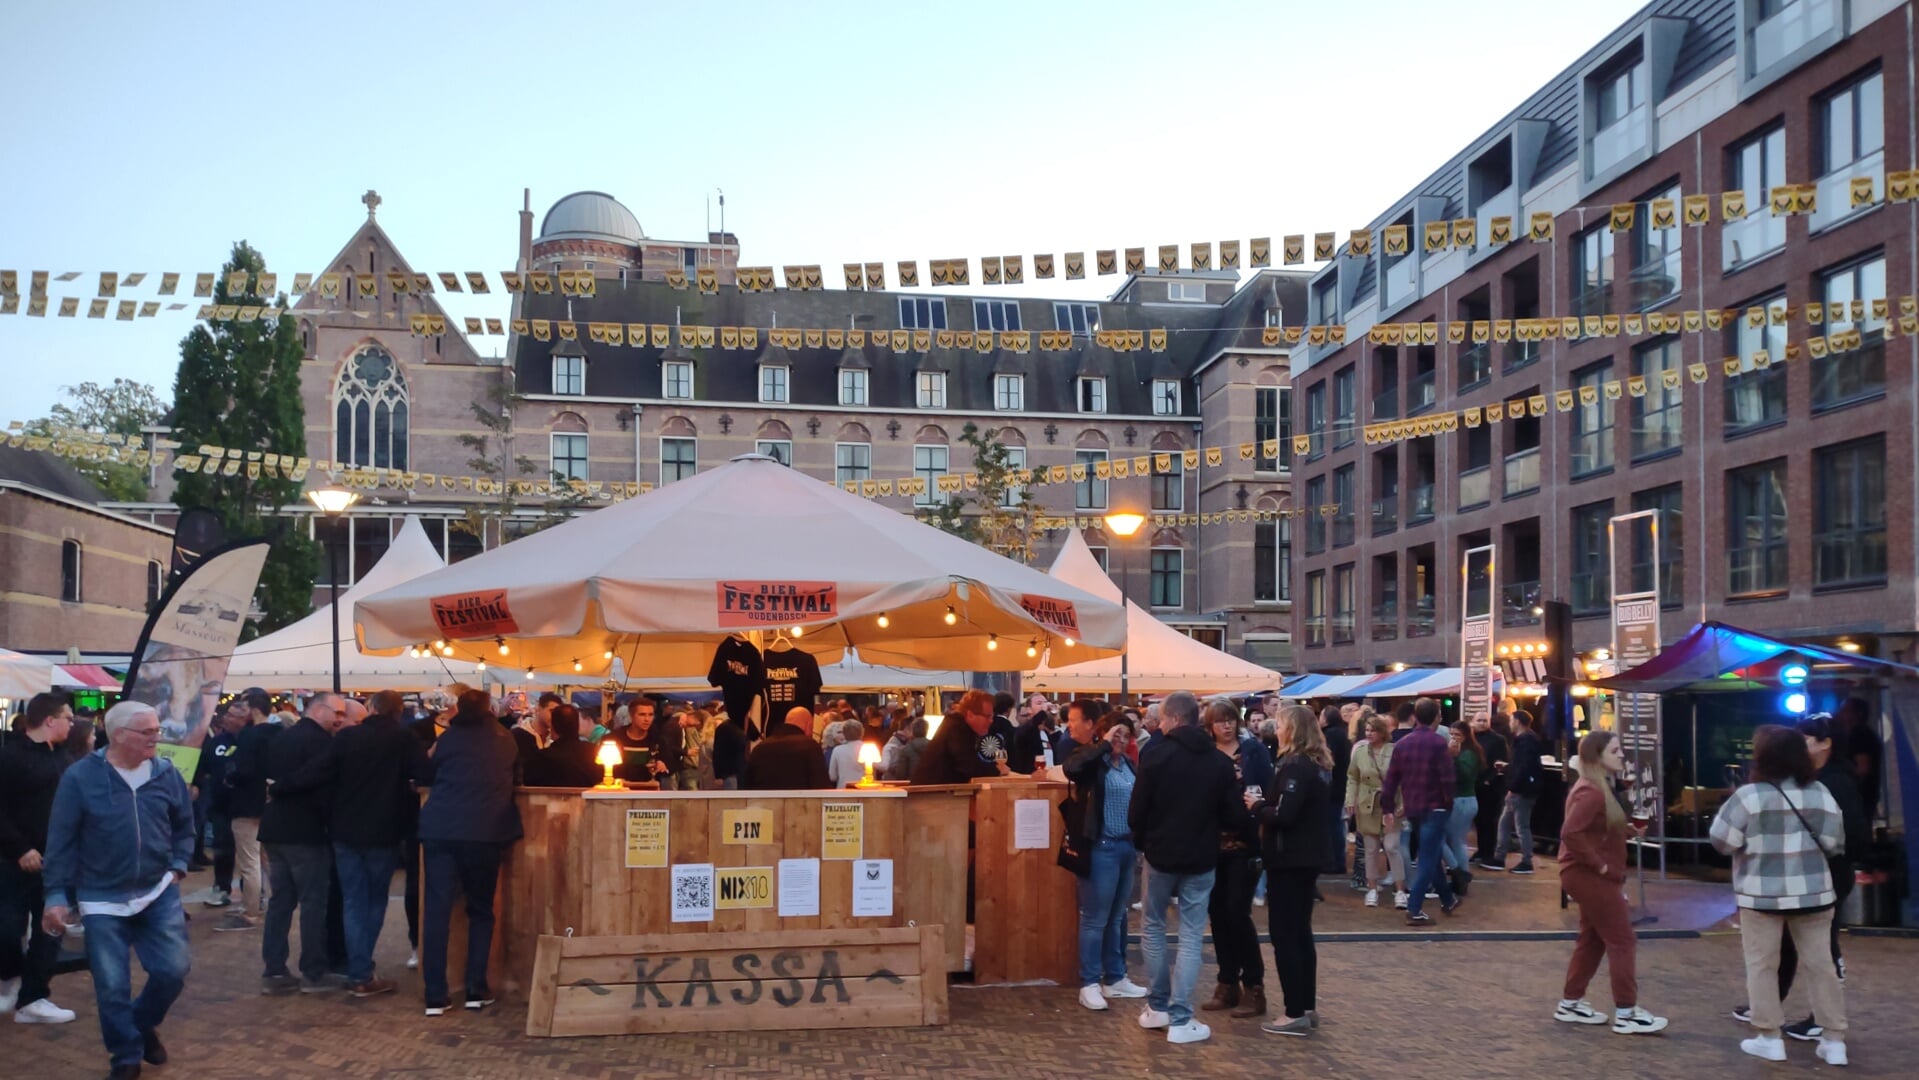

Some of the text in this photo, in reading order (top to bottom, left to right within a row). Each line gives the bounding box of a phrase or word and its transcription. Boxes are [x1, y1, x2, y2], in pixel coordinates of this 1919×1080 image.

[761, 585, 797, 595] BIER
[725, 590, 831, 612] FESTIVAL
[437, 602, 508, 626] FESTIVAL
[748, 612, 807, 621] OUDENBOSCH
[1632, 604, 1653, 620] BELLY
[733, 822, 760, 838] PIN
[631, 950, 851, 1008] KASSA
